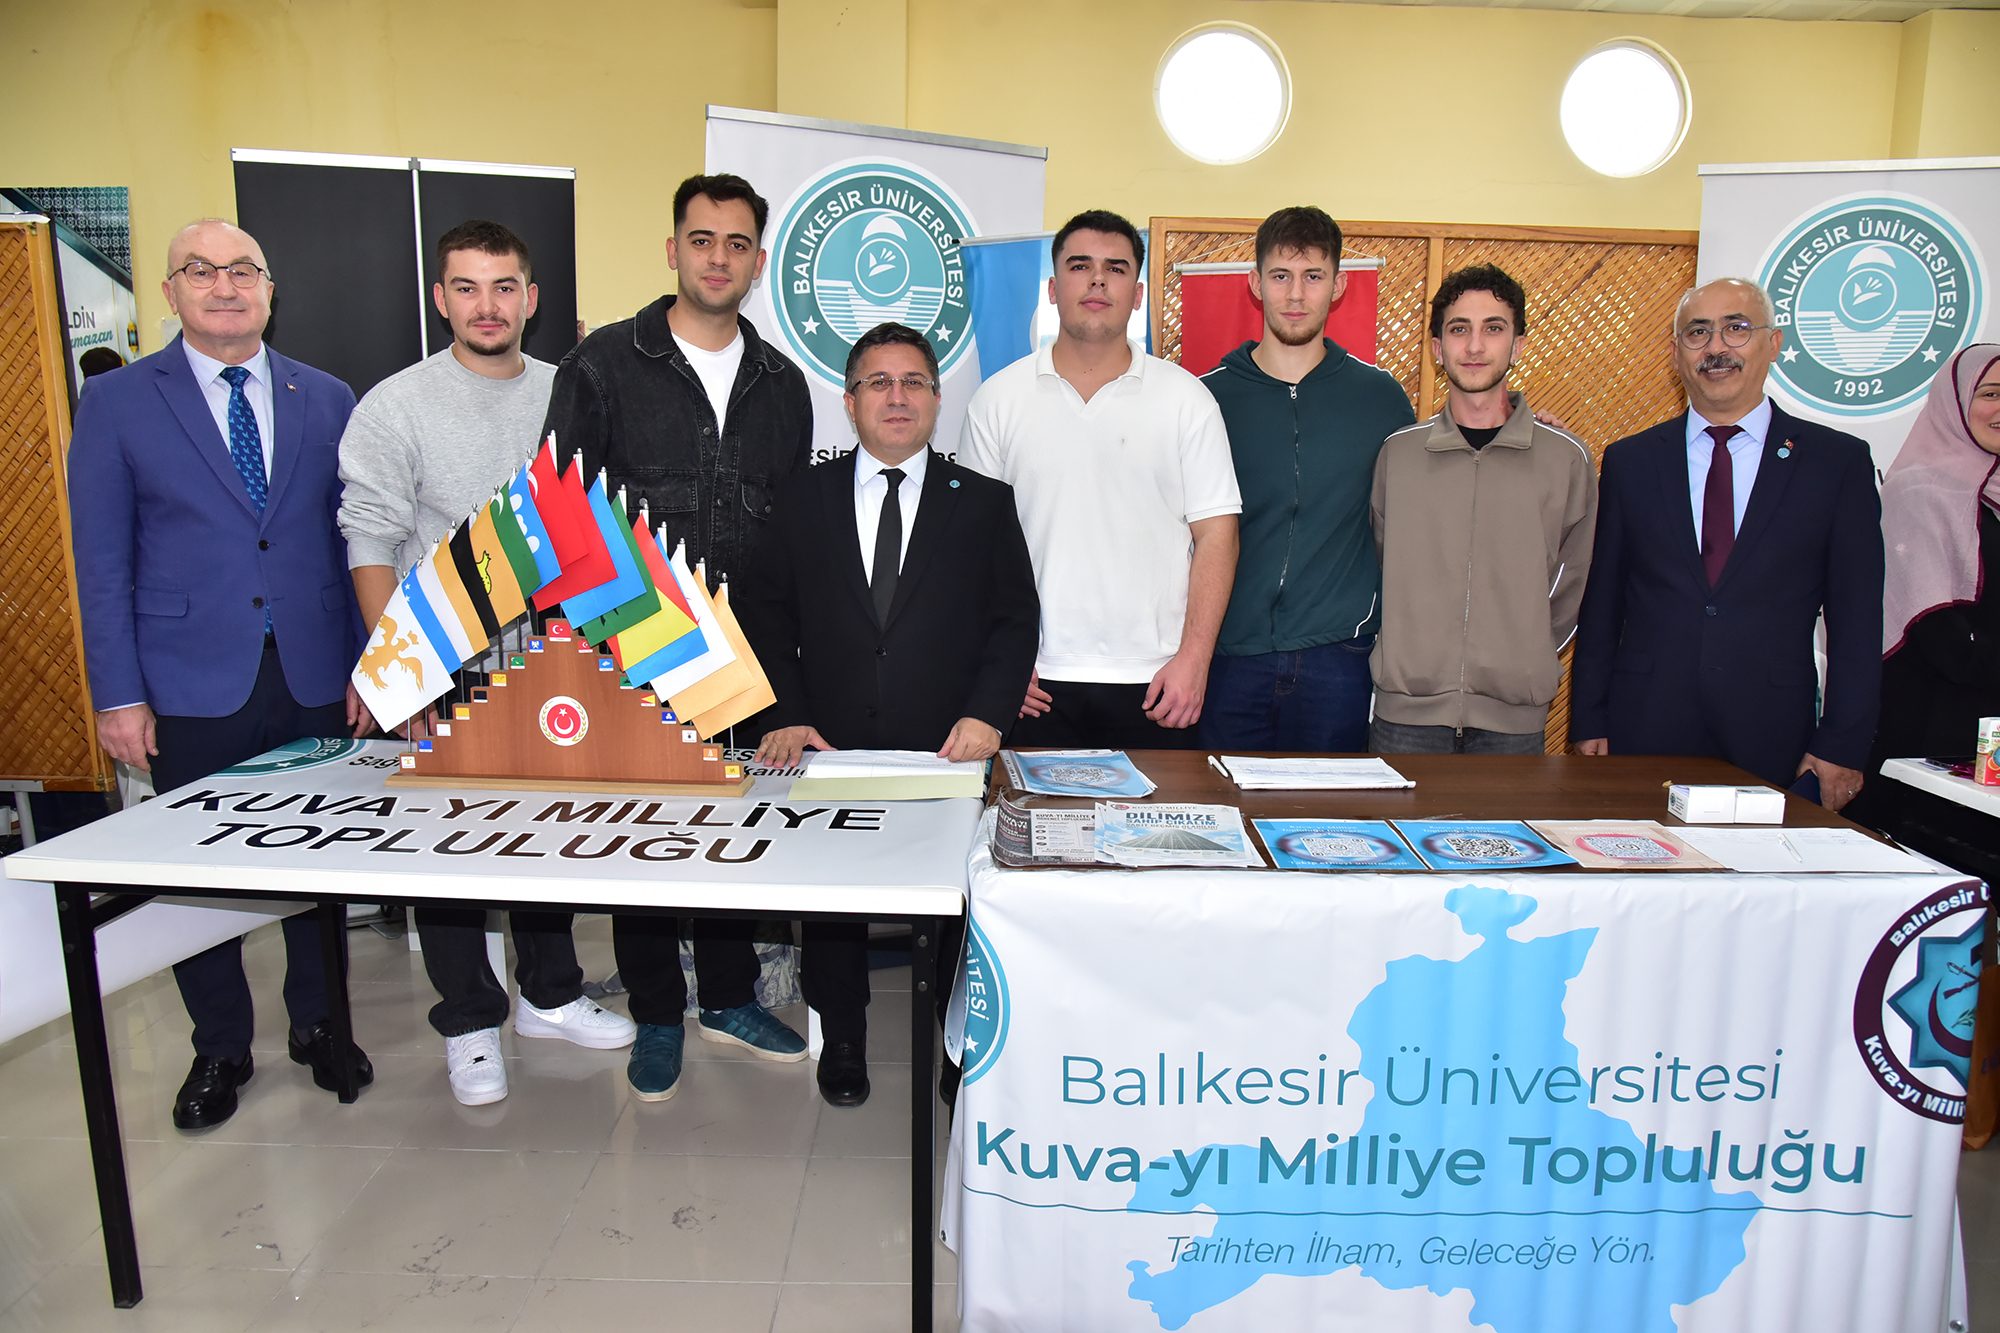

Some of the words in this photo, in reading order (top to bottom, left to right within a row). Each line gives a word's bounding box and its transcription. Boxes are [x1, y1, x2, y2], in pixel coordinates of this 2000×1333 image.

[793, 190, 864, 294] BALIKESİR
[870, 184, 964, 309] ÜNİVERSİTESİ
[1775, 224, 1851, 327] BALIKESİR
[1858, 217, 1957, 329] ÜNİVERSİTESİ
[1833, 378, 1884, 397] 1992
[166, 789, 518, 820] KUVA-YI
[532, 799, 887, 831] MİLLİYE
[197, 822, 772, 863] TOPLULUĞU
[1889, 889, 1975, 947] Balıkesir
[1062, 1051, 1360, 1106] Balıkesir
[1385, 1046, 1783, 1106] Üniversitesi
[1863, 1035, 1921, 1104] Kuva-yı
[977, 1120, 1229, 1198] Kuva-yı
[1259, 1132, 1486, 1199] Milliye
[1508, 1129, 1866, 1197] Topluluğu
[1167, 1235, 1295, 1264] Tarihten
[1306, 1230, 1402, 1267] İlham,
[1419, 1235, 1577, 1270] Geleceğe
[1591, 1235, 1655, 1265] Yön.
